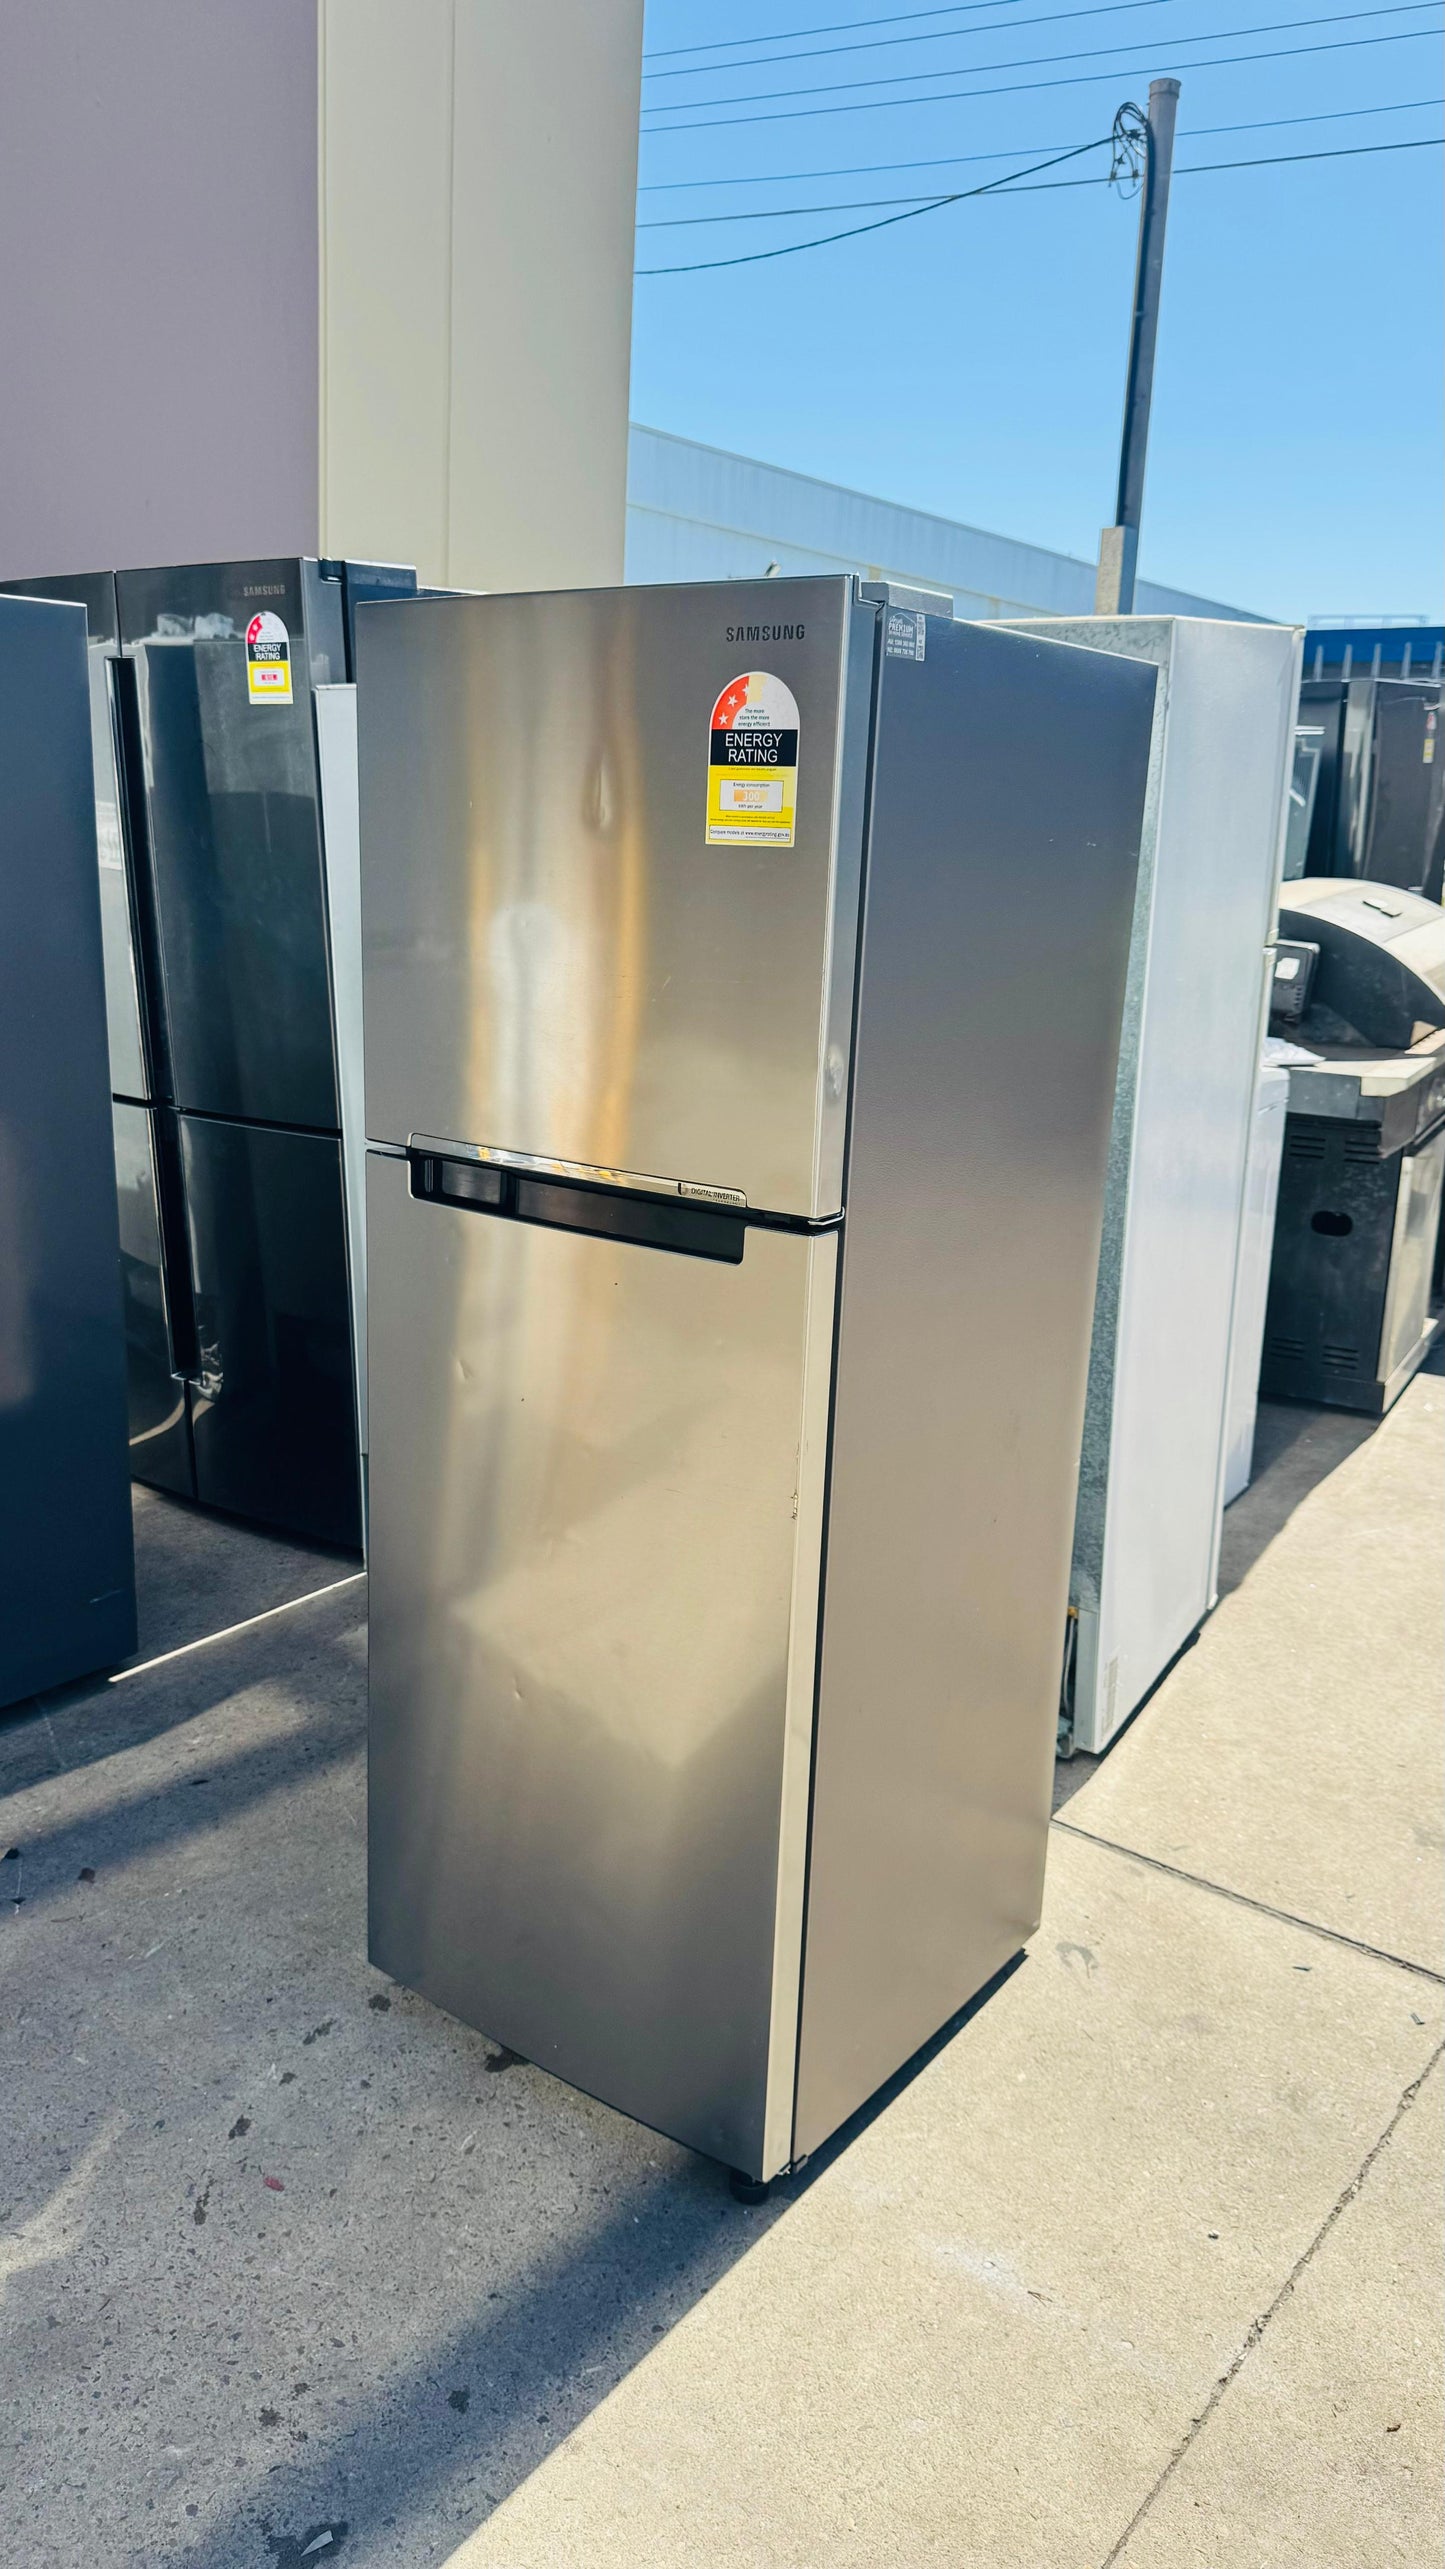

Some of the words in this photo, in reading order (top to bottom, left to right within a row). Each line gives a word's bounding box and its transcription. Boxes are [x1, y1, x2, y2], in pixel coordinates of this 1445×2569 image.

[243, 584, 286, 597] SAMSUNG
[726, 624, 805, 642] SAMSUNG
[253, 644, 281, 653] ENERGY
[255, 652, 281, 661] RATING
[725, 733, 783, 747] ENERGY
[728, 748, 778, 763] RATING
[712, 1191, 740, 1201] INVERTER
